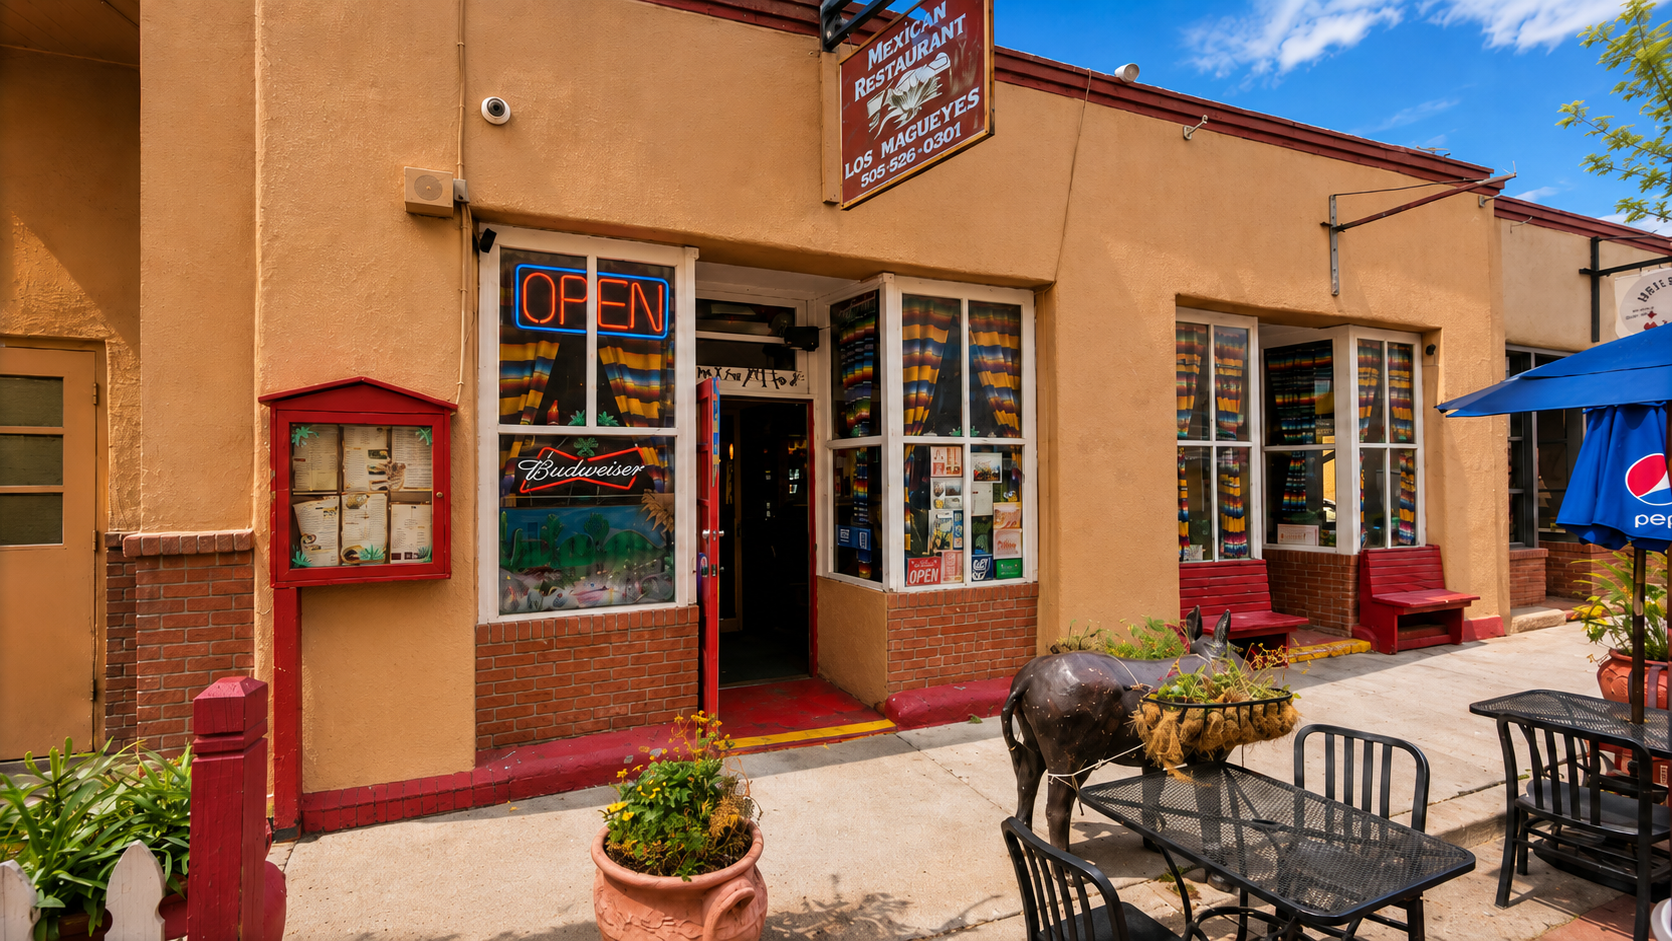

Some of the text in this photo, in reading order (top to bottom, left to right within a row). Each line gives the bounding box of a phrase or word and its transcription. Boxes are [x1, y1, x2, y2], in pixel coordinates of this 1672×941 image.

[854, 13, 966, 102] RESTAURANT
[844, 87, 980, 180] LOS MAGUEYES
[522, 272, 663, 333] OPEN
[518, 459, 645, 482] Budweiser
[910, 568, 939, 584] OPEN
